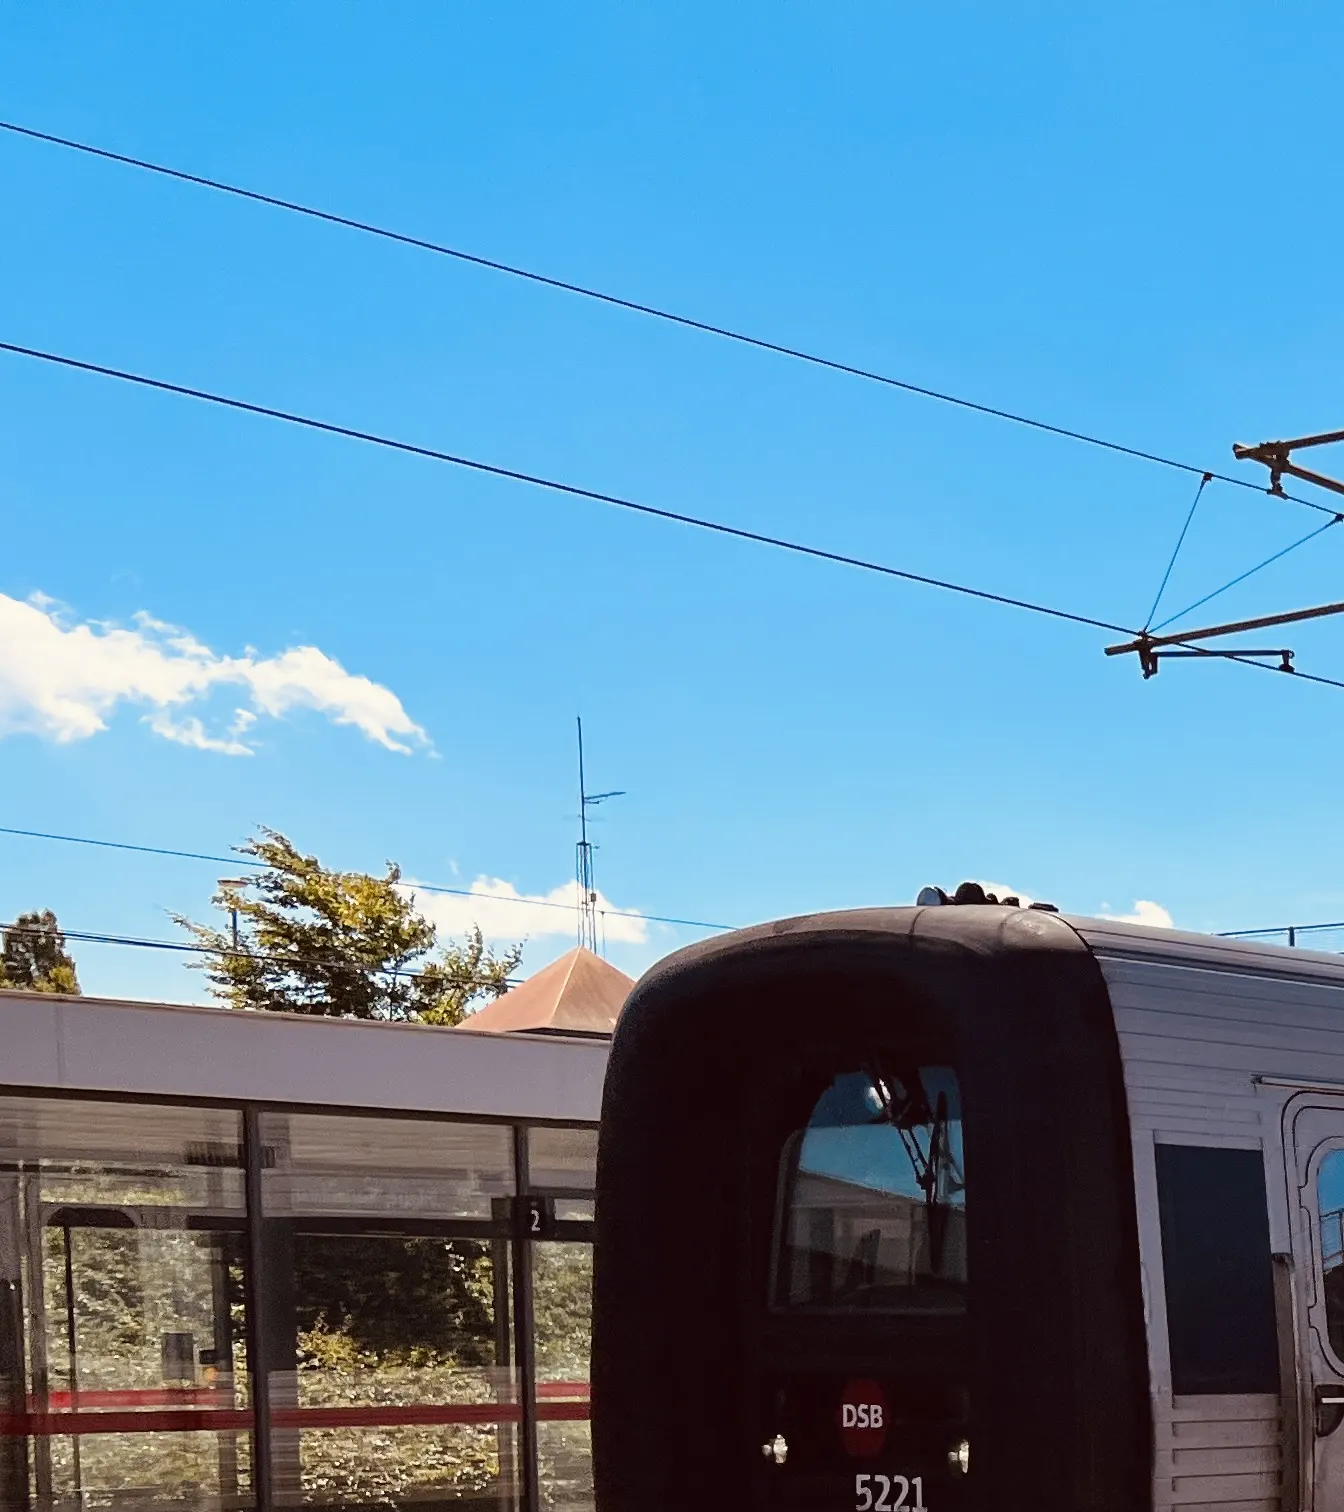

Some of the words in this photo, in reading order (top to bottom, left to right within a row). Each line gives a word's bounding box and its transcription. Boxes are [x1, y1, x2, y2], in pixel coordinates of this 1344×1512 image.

[531, 1209, 540, 1231] 2
[842, 1404, 883, 1428] DSB
[855, 1474, 928, 1512] 5221
